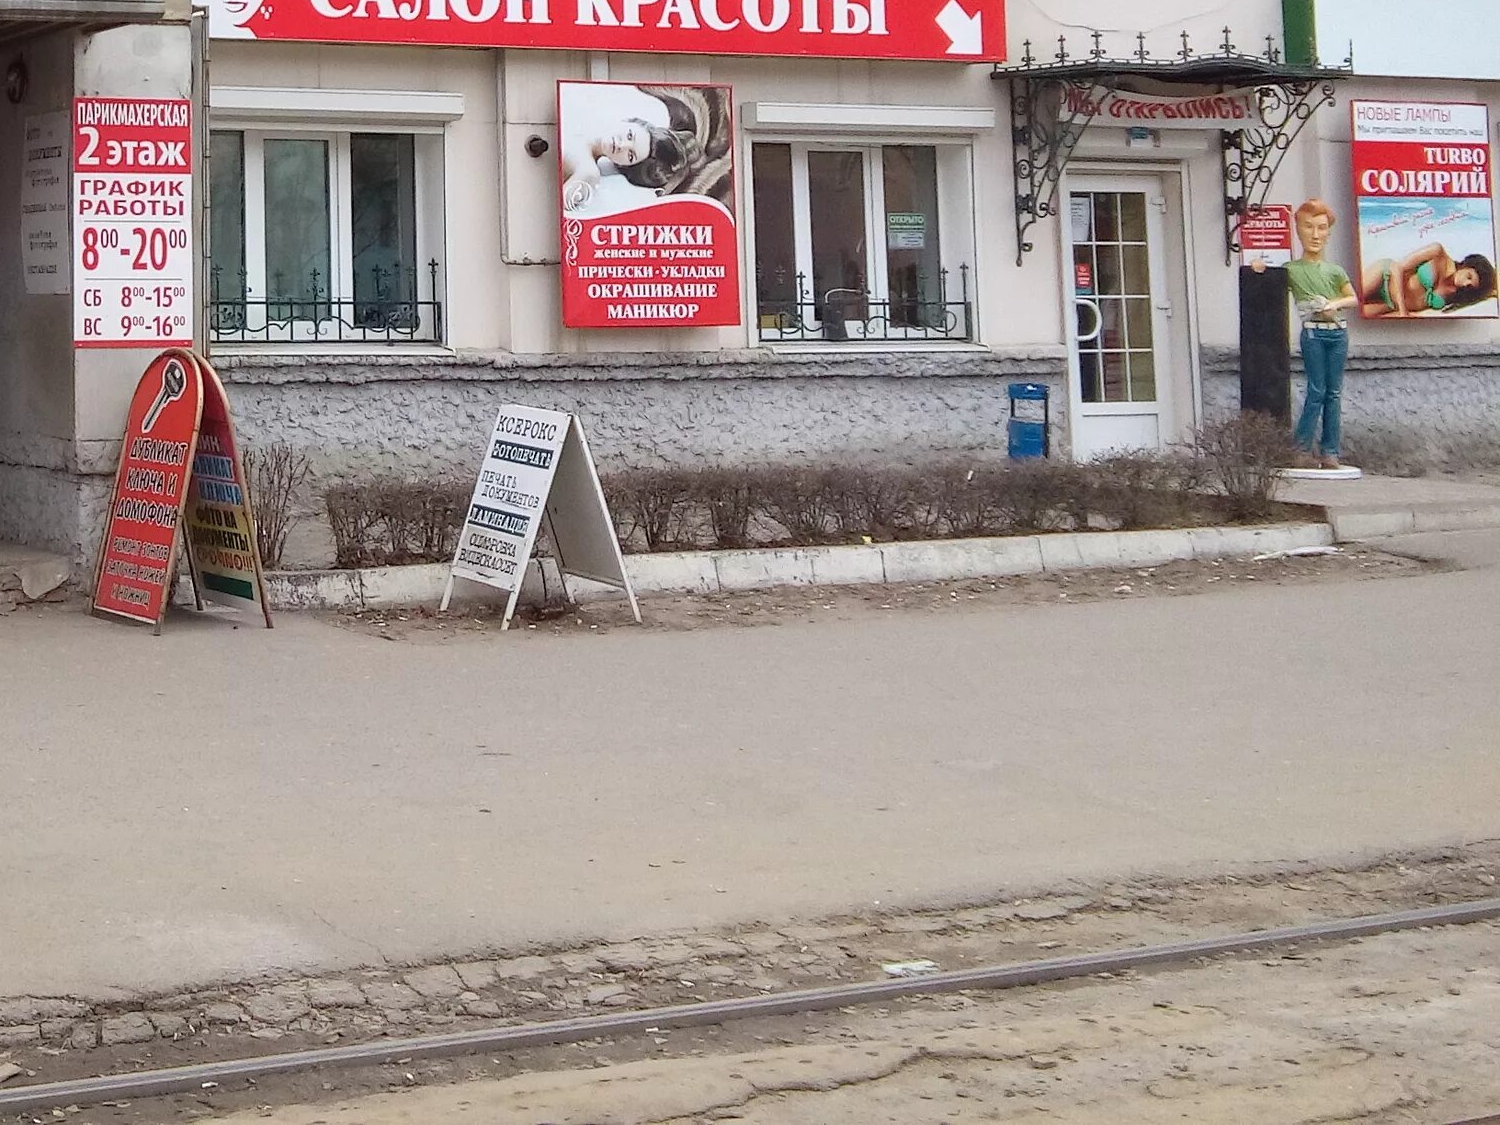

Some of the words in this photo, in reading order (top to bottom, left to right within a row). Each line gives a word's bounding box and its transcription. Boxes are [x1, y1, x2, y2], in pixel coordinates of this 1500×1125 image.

[77, 102, 188, 127] ПАРИКМАХЕРСКАЯ
[1357, 106, 1401, 121] НОВЫЕ
[1405, 108, 1451, 122] ЛАМПЫ
[78, 126, 100, 166] 2
[106, 140, 186, 167] этаж
[1423, 147, 1486, 165] TURBO
[79, 179, 185, 197] ГРАФИК
[1361, 166, 1488, 194] СОЛЯРИЙ
[79, 199, 185, 216] РАБОТЫ
[590, 225, 714, 246] СТРИЖКИ
[593, 248, 646, 259] женские
[649, 249, 658, 259] и
[660, 248, 714, 261] мужские
[578, 265, 654, 279] ПРИЧЕСКИ
[661, 265, 726, 280] УКЛАДКИ
[83, 288, 102, 307] СБ
[587, 284, 718, 298] ОКРАШИВАНИЕ
[607, 304, 699, 319] МАНИКЮР
[83, 318, 102, 335] ВС
[496, 415, 557, 441] КСЕРОКС
[129, 437, 189, 467] ДУБЛИКАТ
[492, 442, 552, 467] ФОТОПЕЧАТЬ
[125, 467, 165, 496] КЛЮЧА
[167, 471, 178, 497] И
[481, 470, 517, 489] ПЕЧАТЬ
[481, 485, 540, 508] ДОКУМЕНТОВ
[115, 495, 180, 530] ДОМОФОНА
[470, 507, 528, 533] ЛАМИНАЦИЯ
